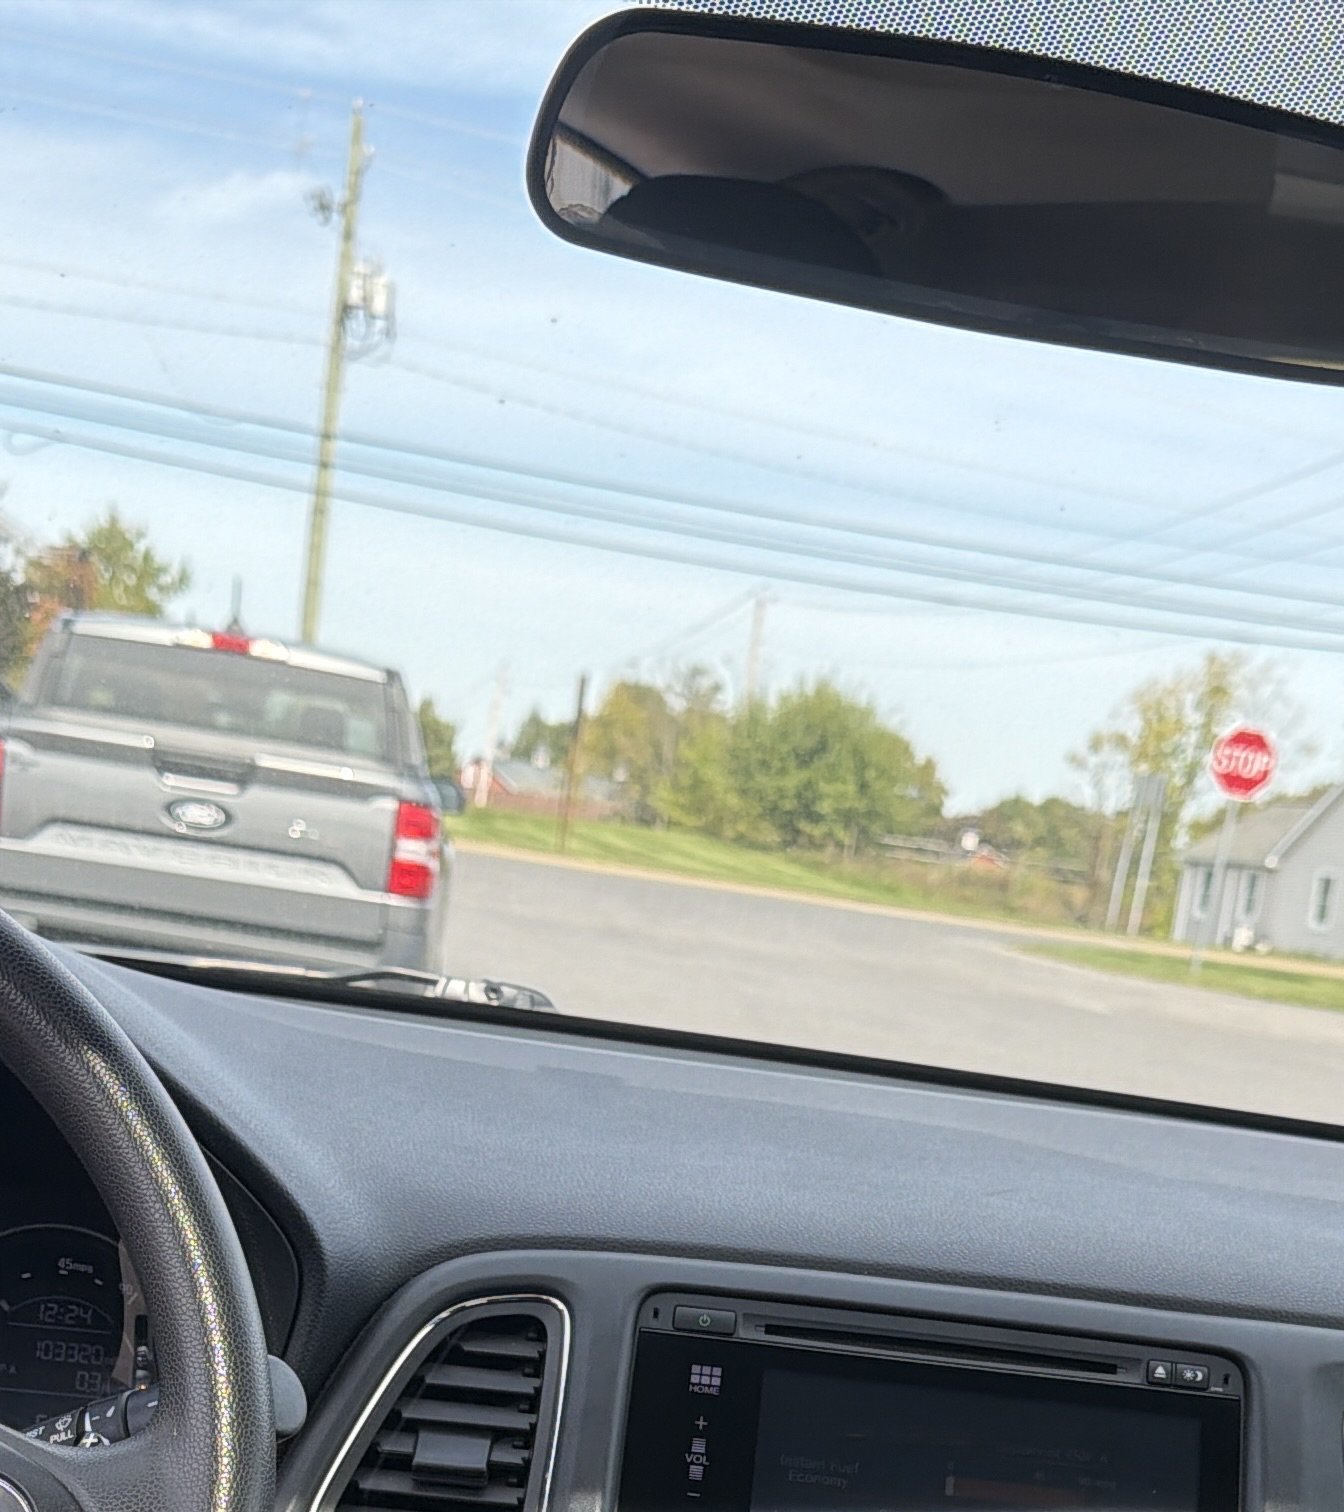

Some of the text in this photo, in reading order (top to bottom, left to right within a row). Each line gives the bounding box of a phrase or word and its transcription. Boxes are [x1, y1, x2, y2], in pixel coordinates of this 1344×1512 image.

[1212, 743, 1270, 779] STOP
[57, 1257, 94, 1275] 45mpg
[39, 1303, 93, 1325] 12:24
[36, 1340, 105, 1365] 103320
[689, 1384, 721, 1397] HOME
[49, 1429, 75, 1445] PULL
[684, 1452, 710, 1466] VOL
[788, 1470, 849, 1490] Economy
